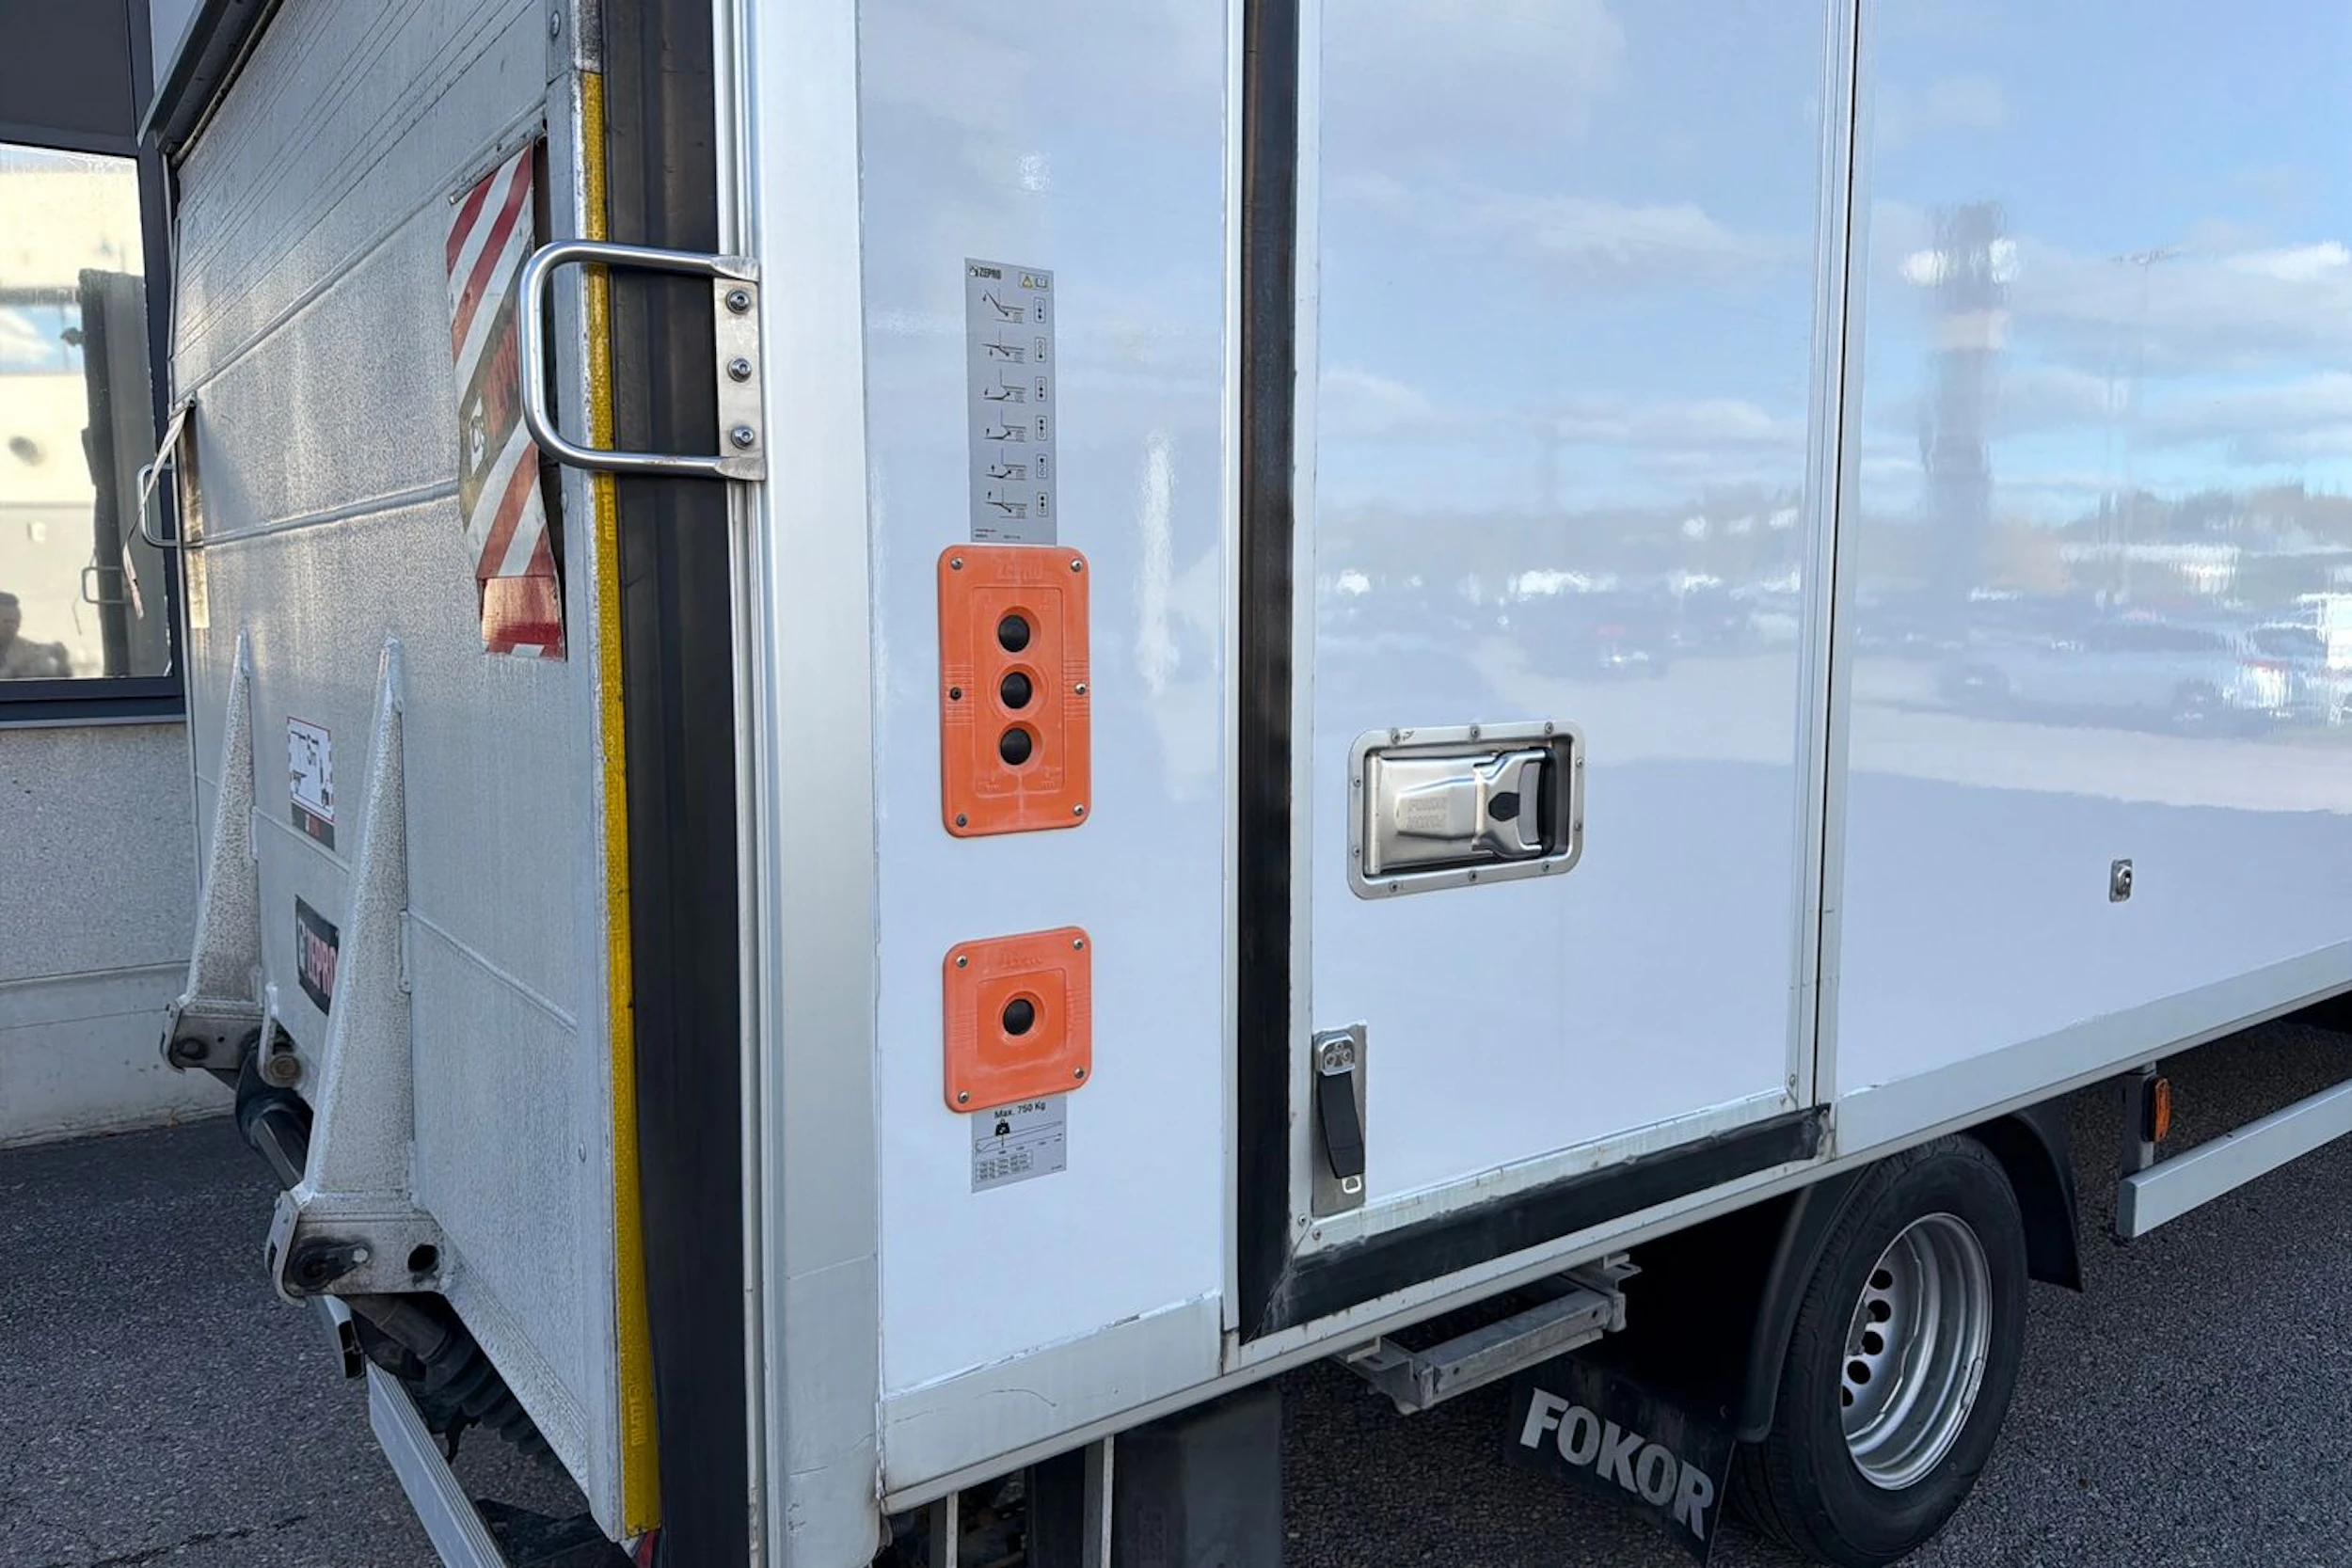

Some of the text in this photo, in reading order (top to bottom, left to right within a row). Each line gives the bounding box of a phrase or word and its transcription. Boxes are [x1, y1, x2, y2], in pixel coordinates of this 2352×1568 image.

[994, 1101, 1046, 1118] Max. 750 Kg
[1519, 1388, 1714, 1540] FOKOR
